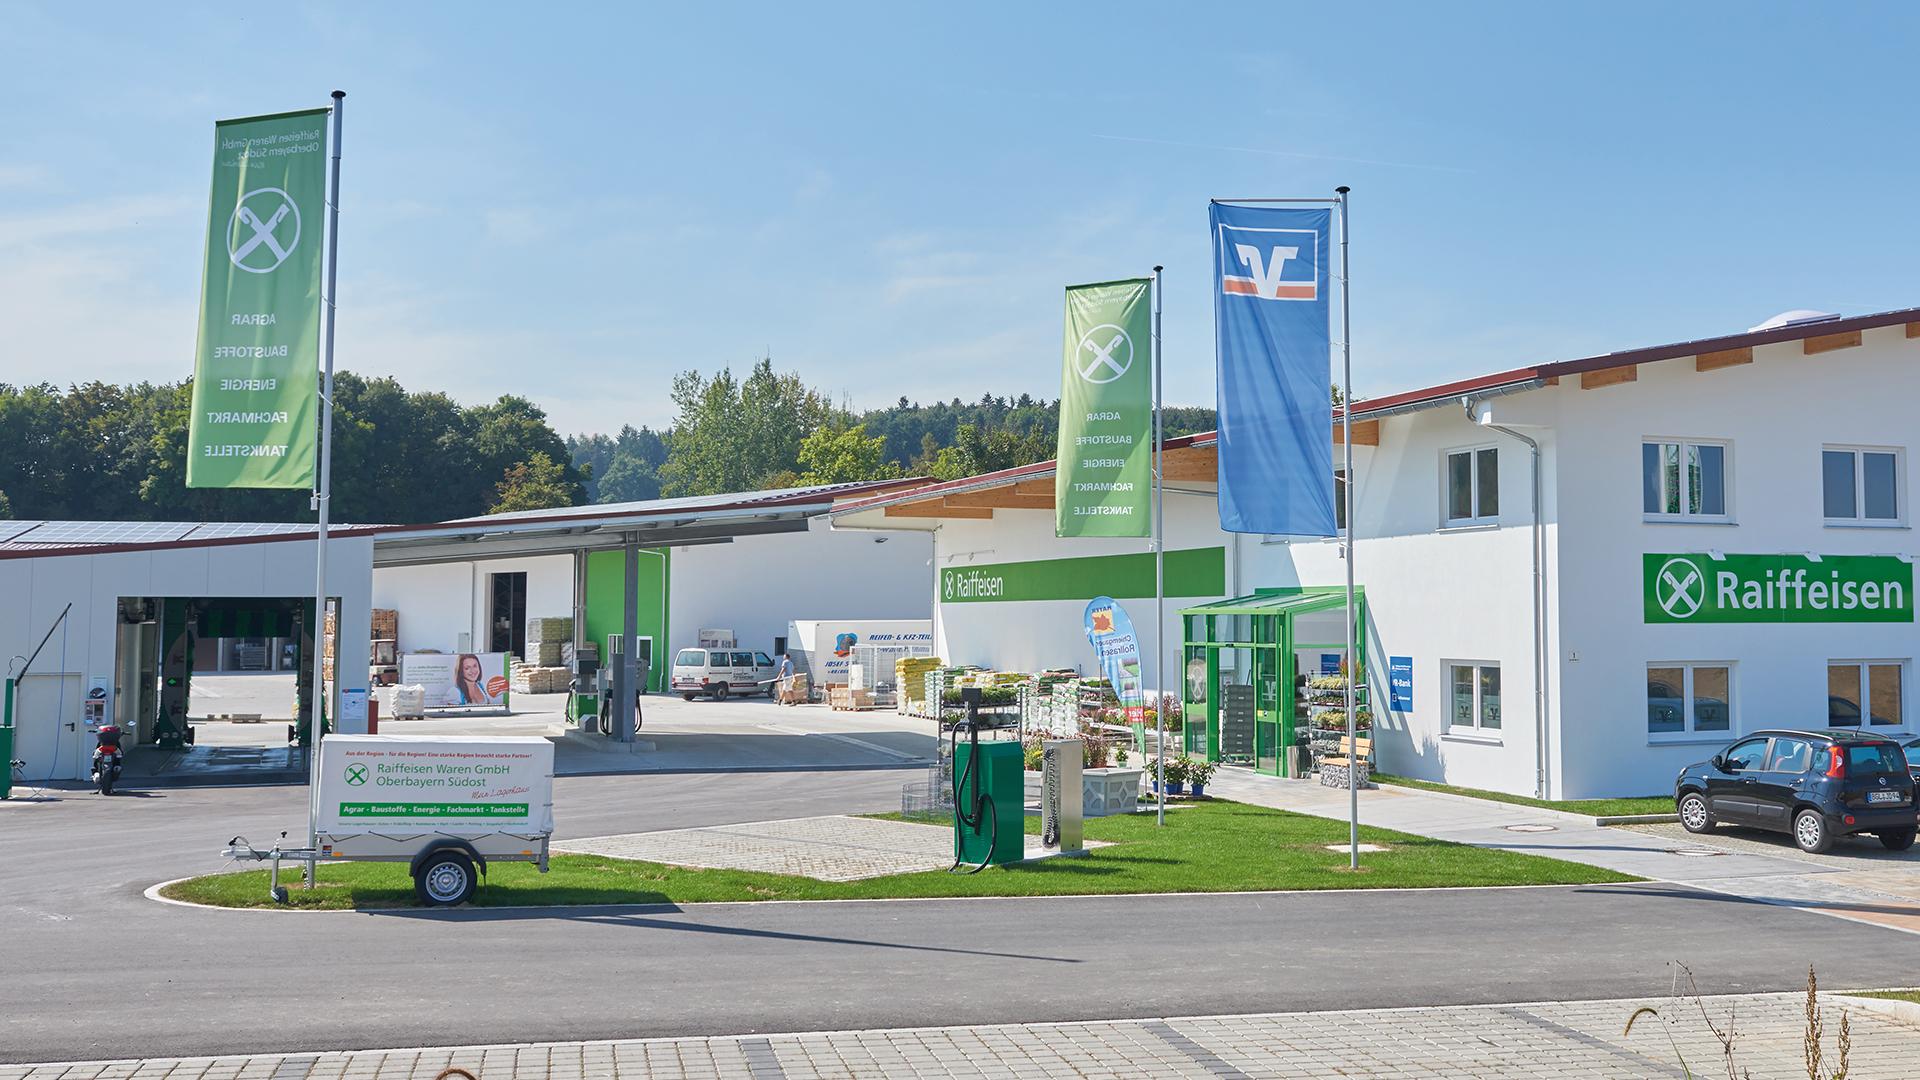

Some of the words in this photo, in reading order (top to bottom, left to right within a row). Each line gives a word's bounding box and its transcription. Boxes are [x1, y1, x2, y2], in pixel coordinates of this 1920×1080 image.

[957, 570, 1003, 597] Raiffeisen
[1716, 569, 1904, 609] Raiffeisen
[377, 763, 433, 774] Raiffeisen
[436, 764, 472, 774] Waren
[475, 764, 510, 774] GmbH
[376, 776, 445, 788] Oberbayern
[447, 776, 487, 787] Südost
[344, 806, 364, 814] Agrar
[371, 805, 407, 813] Baustoffe
[413, 806, 440, 814] Energie
